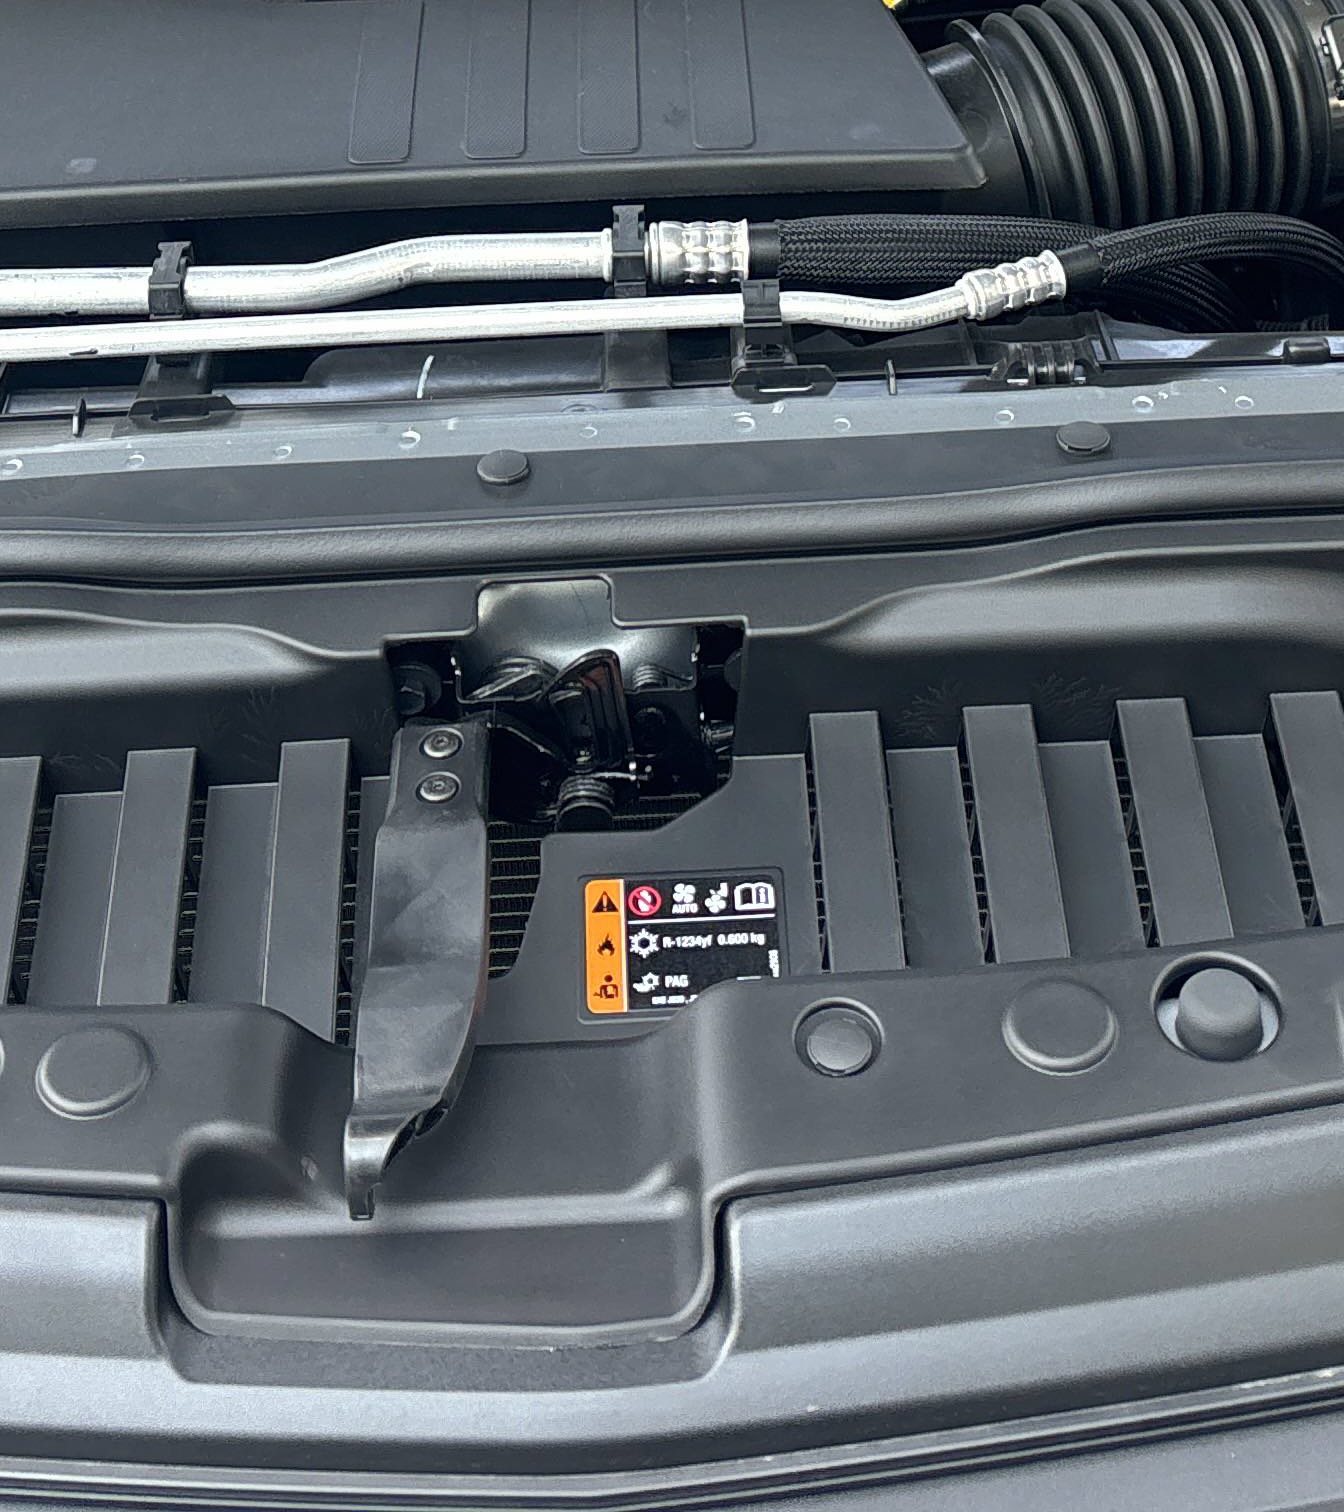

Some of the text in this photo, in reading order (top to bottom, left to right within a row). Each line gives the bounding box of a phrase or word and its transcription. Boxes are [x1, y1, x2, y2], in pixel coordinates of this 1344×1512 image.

[672, 903, 698, 914] AUTO
[662, 932, 765, 948] R-1234yf 0.600 kg
[664, 974, 689, 988] PAG
